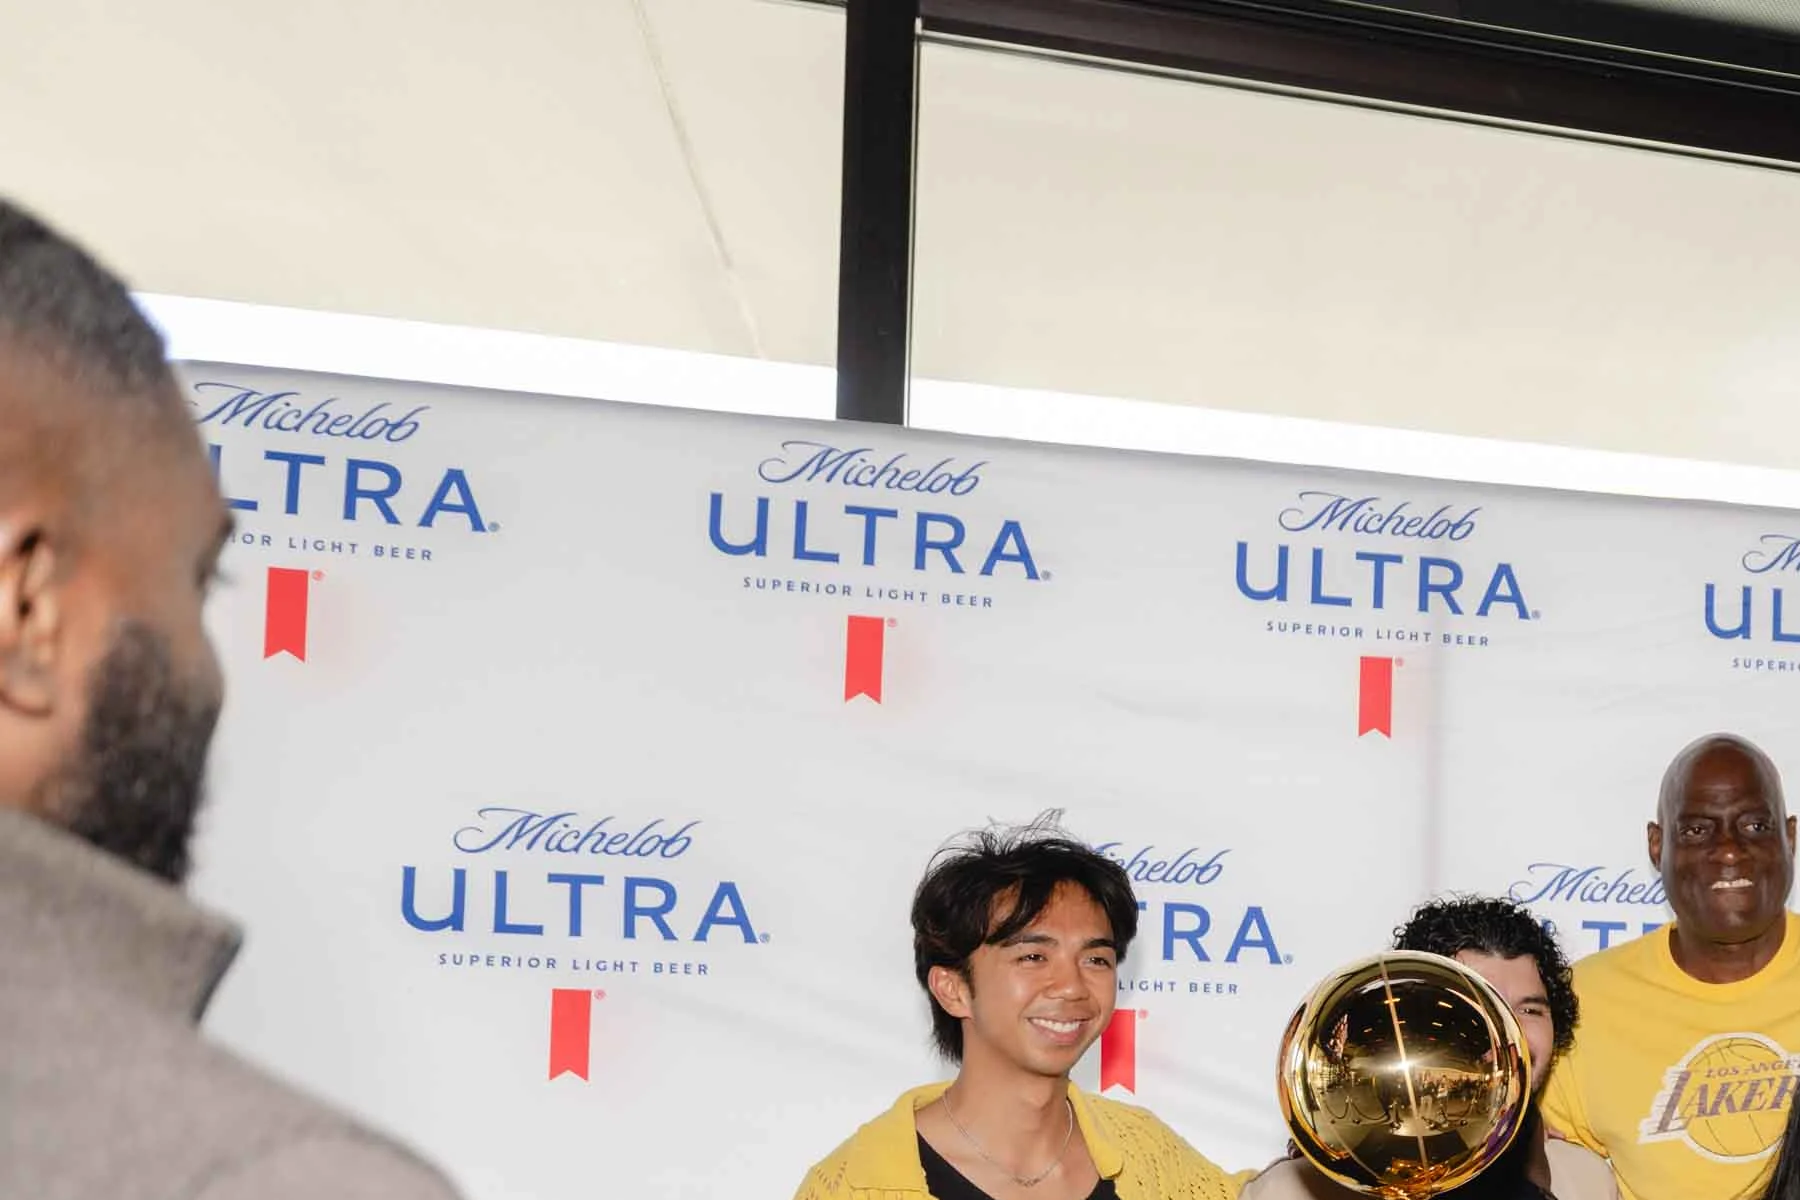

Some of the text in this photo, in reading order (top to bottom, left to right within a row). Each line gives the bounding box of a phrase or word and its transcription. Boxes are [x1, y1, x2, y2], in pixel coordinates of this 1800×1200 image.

[193, 382, 430, 442] Michelob
[209, 443, 487, 532] LTRA
[759, 441, 989, 495] Michelob
[708, 492, 1040, 581] ULTRA
[1279, 491, 1483, 541] Michelob
[288, 536, 358, 554] LIGHT
[374, 545, 433, 561] BEER
[743, 577, 993, 608] SUPERIOR LIGHT BEER
[1236, 541, 1530, 620] ULTRA
[1267, 621, 1489, 646] SUPERIOR LIGHT BEER
[454, 808, 702, 858] Michelob
[401, 866, 759, 944] ULTRA
[439, 953, 709, 975] SUPERIOR LIGHT BEER
[1118, 980, 1238, 994] LIGHT BEER
[1705, 1066, 1740, 1079] LOS
[1648, 1070, 1800, 1135] LAKER
